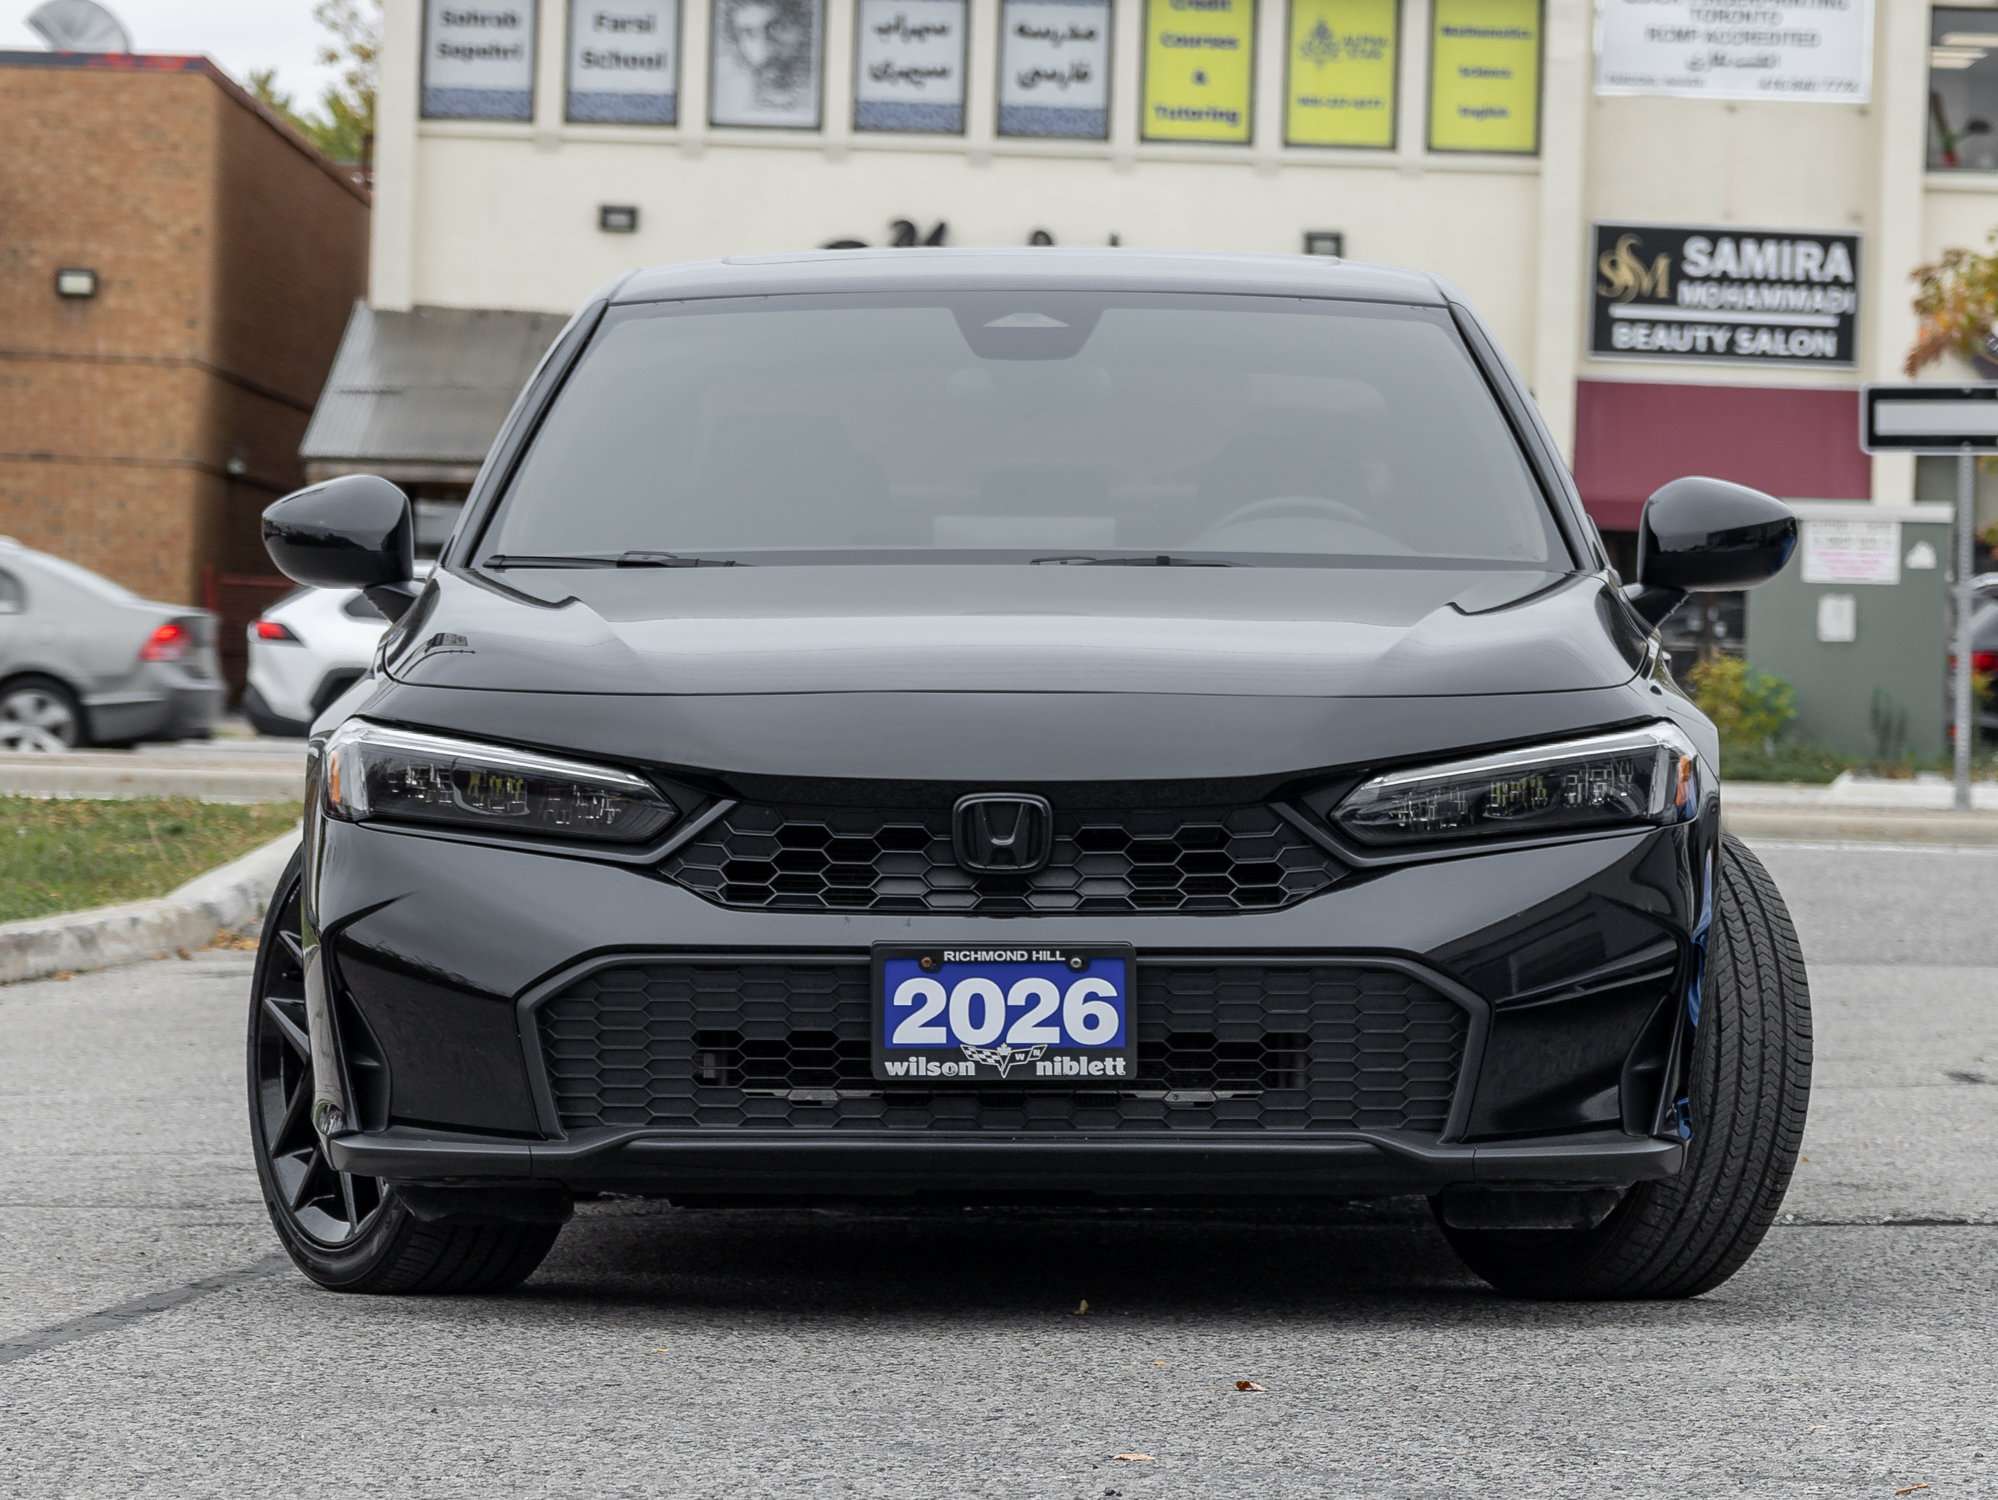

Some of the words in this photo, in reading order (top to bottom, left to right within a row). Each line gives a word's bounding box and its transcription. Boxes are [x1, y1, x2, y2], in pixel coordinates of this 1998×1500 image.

[593, 13, 656, 33] Farsi
[580, 50, 666, 70] School
[1681, 235, 1855, 282] SAMIRA
[1611, 321, 1732, 352] BEAUTY
[1733, 326, 1838, 358] SALON
[943, 950, 1029, 962] RICHMOND
[1032, 950, 1066, 962] HILL
[892, 976, 1120, 1046] 2026
[884, 1056, 976, 1076] wilson
[1036, 1056, 1126, 1076] niblett
